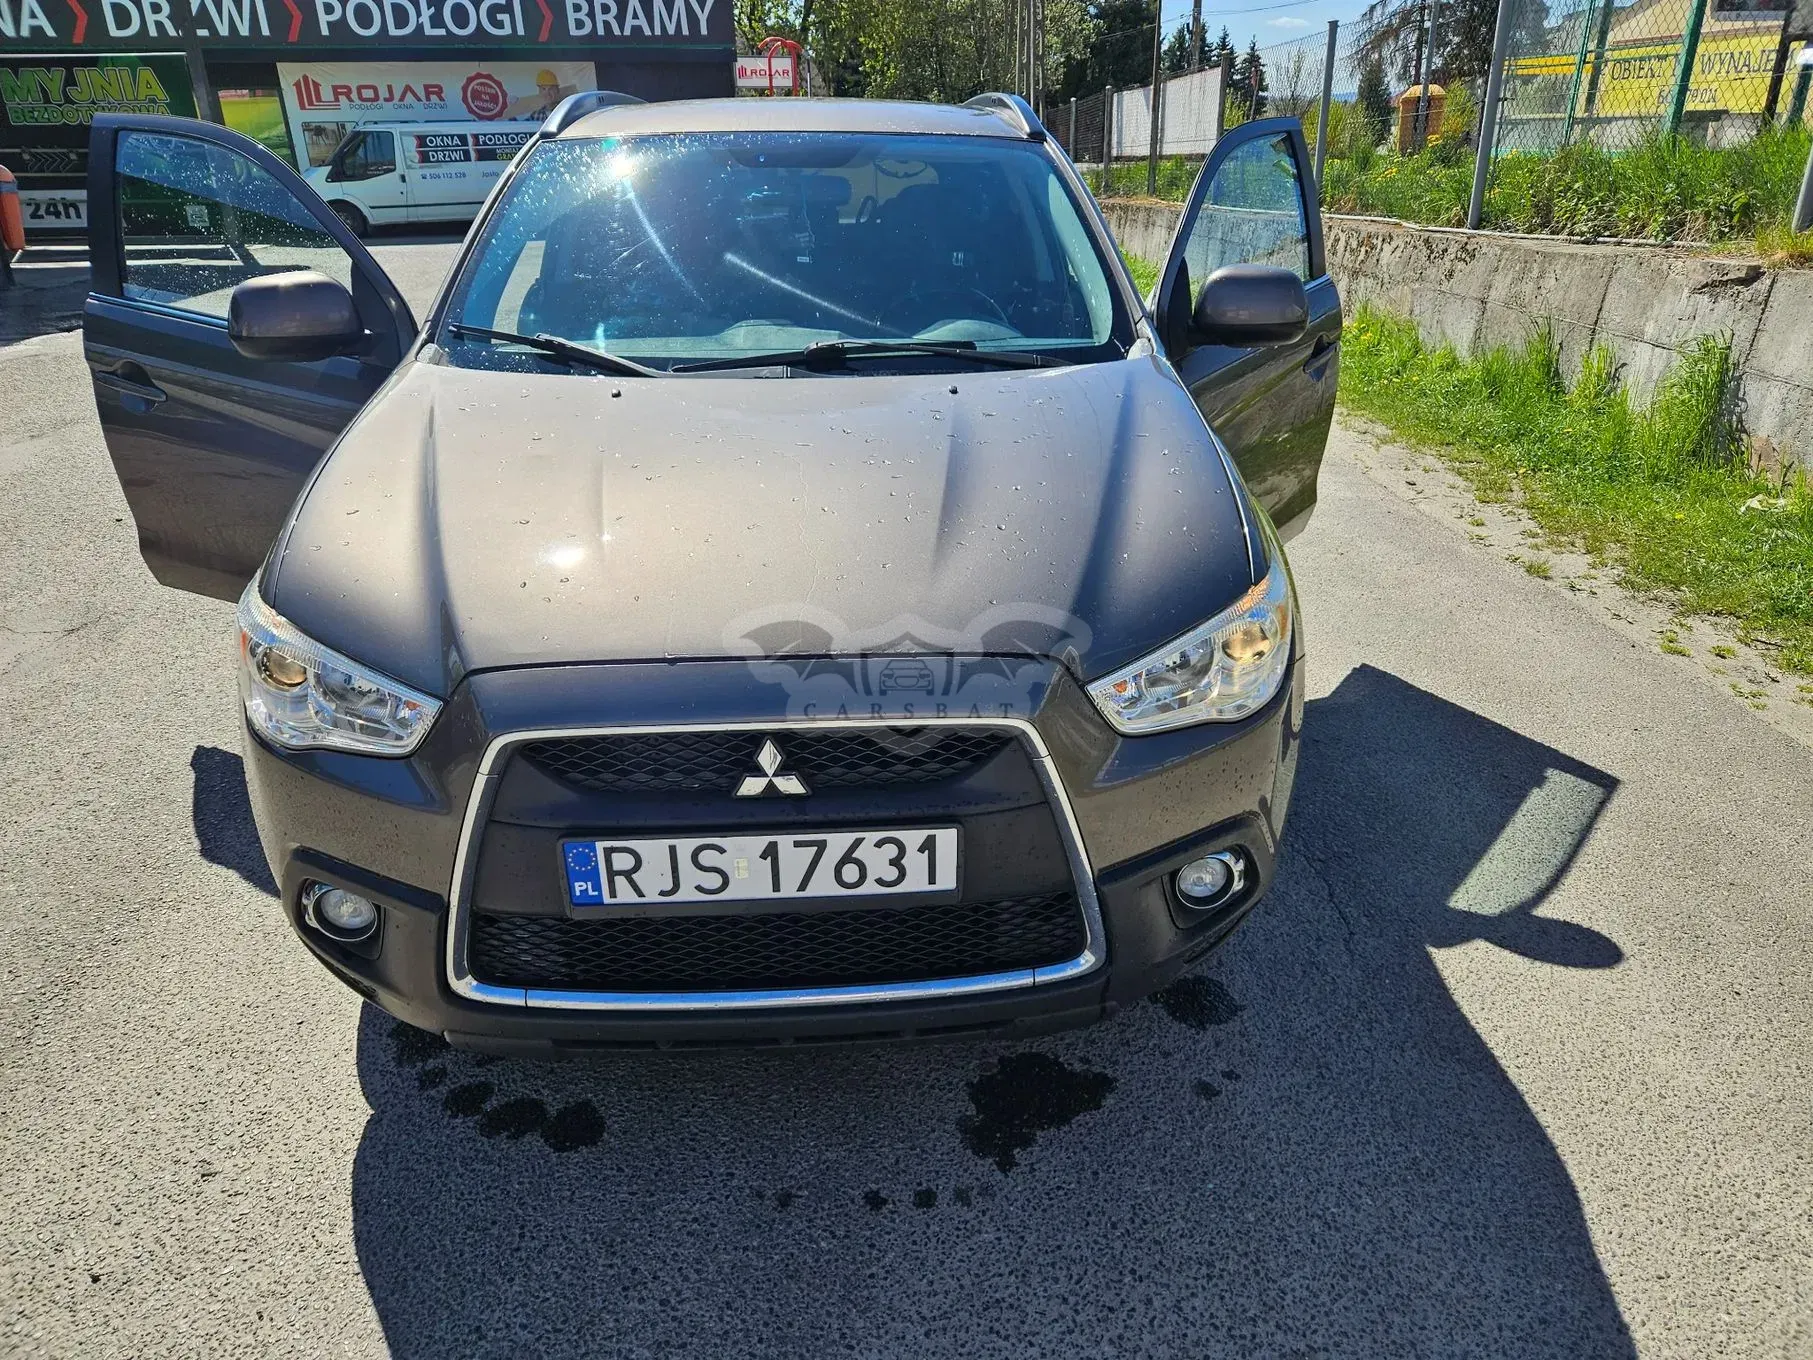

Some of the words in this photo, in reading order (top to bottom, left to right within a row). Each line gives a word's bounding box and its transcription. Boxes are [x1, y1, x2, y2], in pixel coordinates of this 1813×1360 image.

[315, 0, 525, 36] PODŁOGI
[565, 0, 714, 36] BRAMY
[750, 68, 790, 77] ROAR
[1612, 57, 1667, 80] OBIEKT
[0, 67, 169, 103] MYJNIA
[331, 83, 446, 102] ROJAR
[423, 102, 448, 110] DRZWI
[426, 135, 461, 147] OKNA
[429, 150, 464, 161] DRZWI
[26, 197, 82, 220] 24h
[603, 844, 731, 900] RJS
[759, 833, 938, 893] 17631
[575, 881, 598, 897] PL
